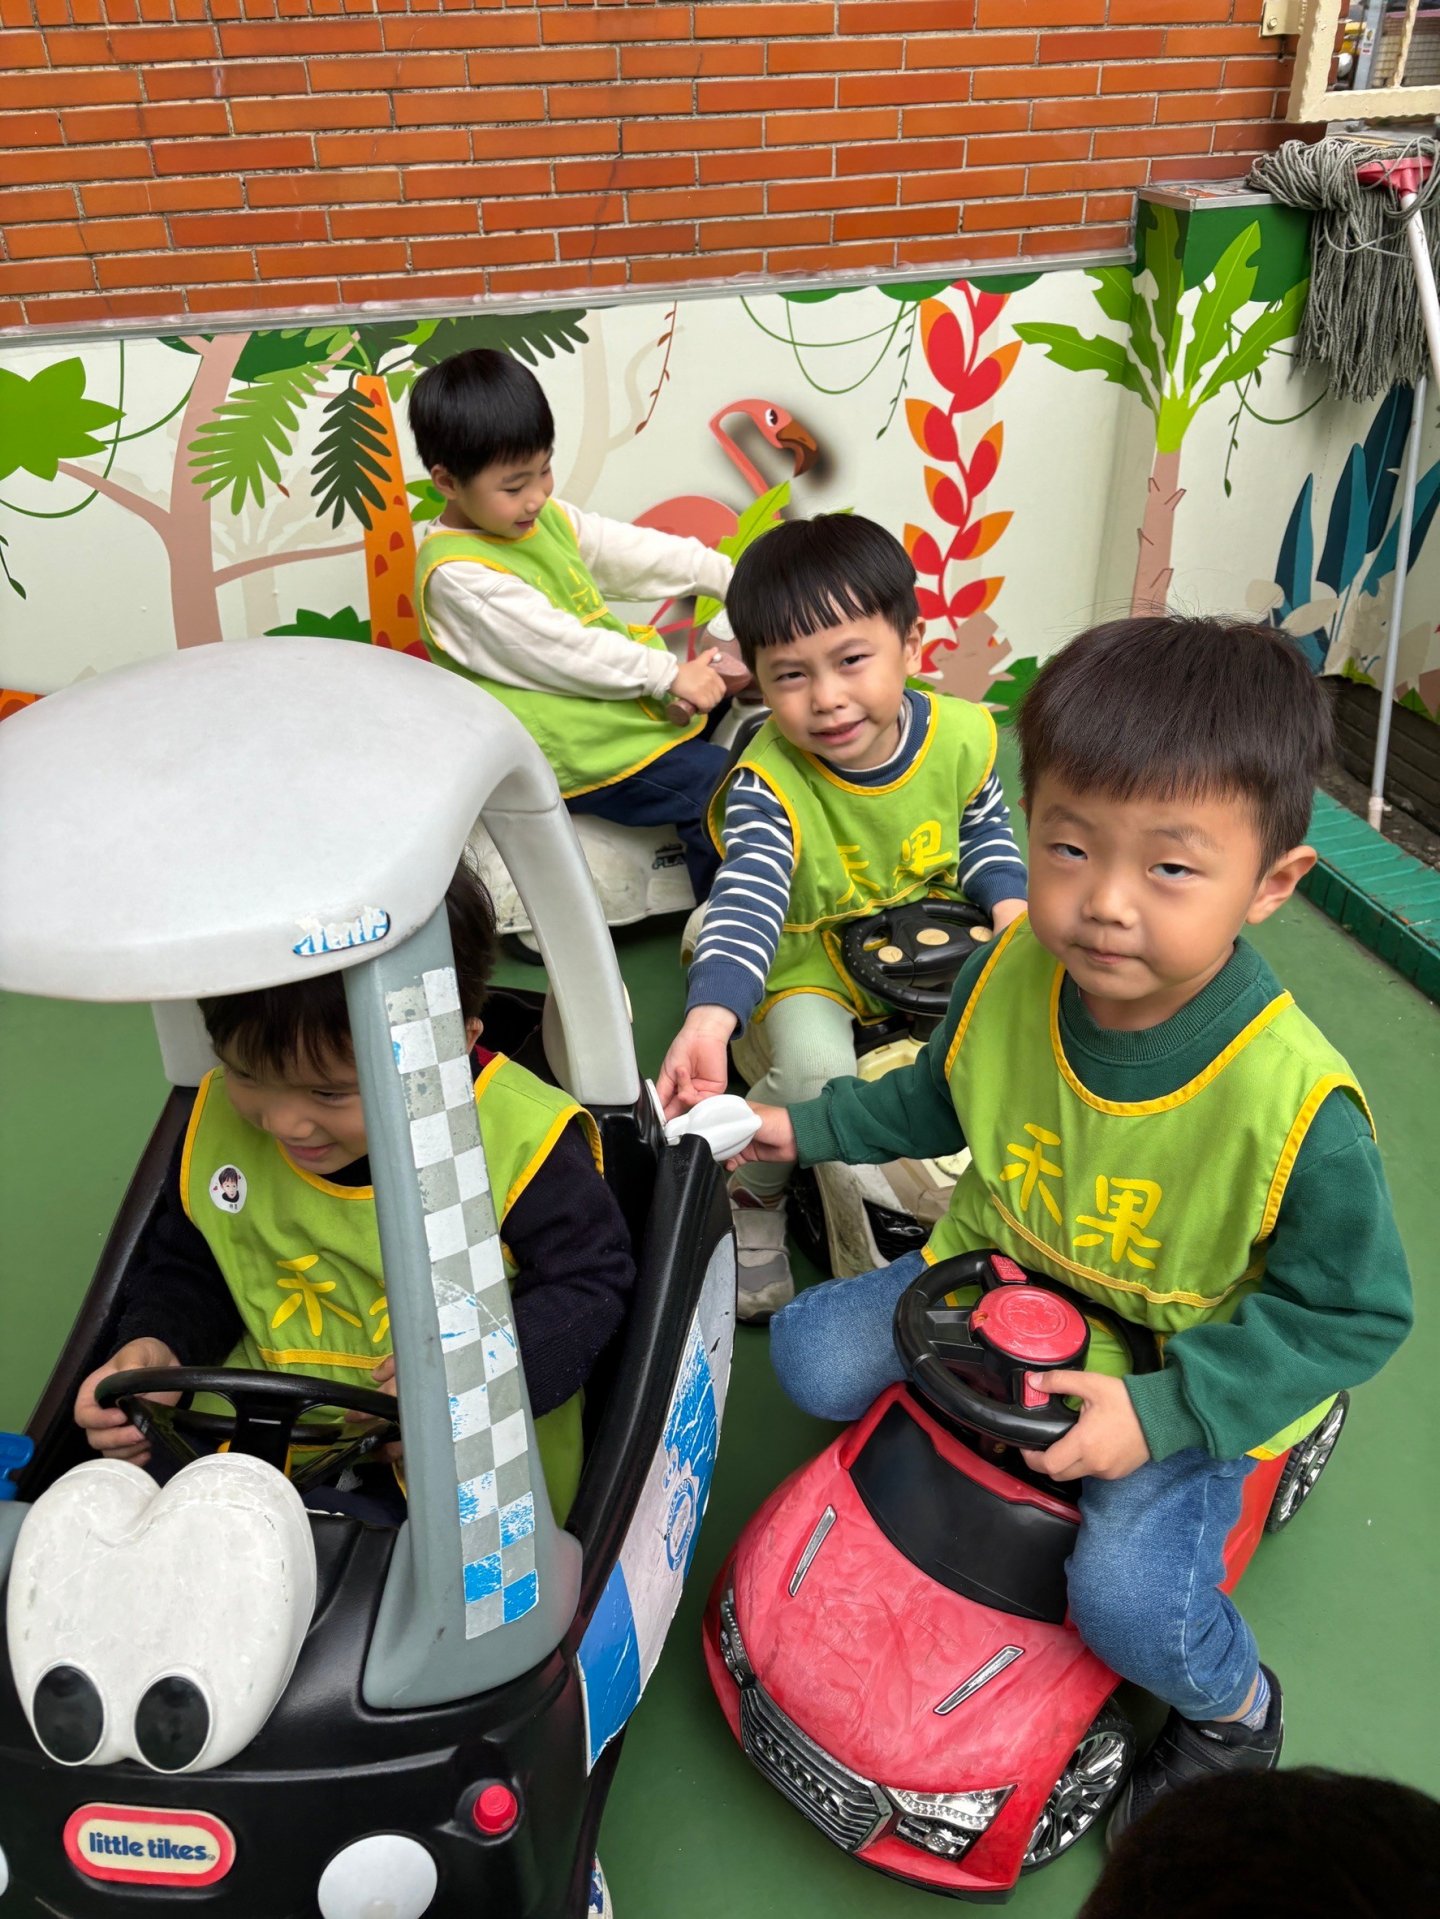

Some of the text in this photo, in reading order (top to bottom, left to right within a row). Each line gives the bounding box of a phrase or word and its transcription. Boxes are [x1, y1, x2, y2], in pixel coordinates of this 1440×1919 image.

[1000, 1122, 1163, 1270] 禾果
[271, 1254, 391, 1343] 禾
[89, 1831, 207, 1860] little tikes
